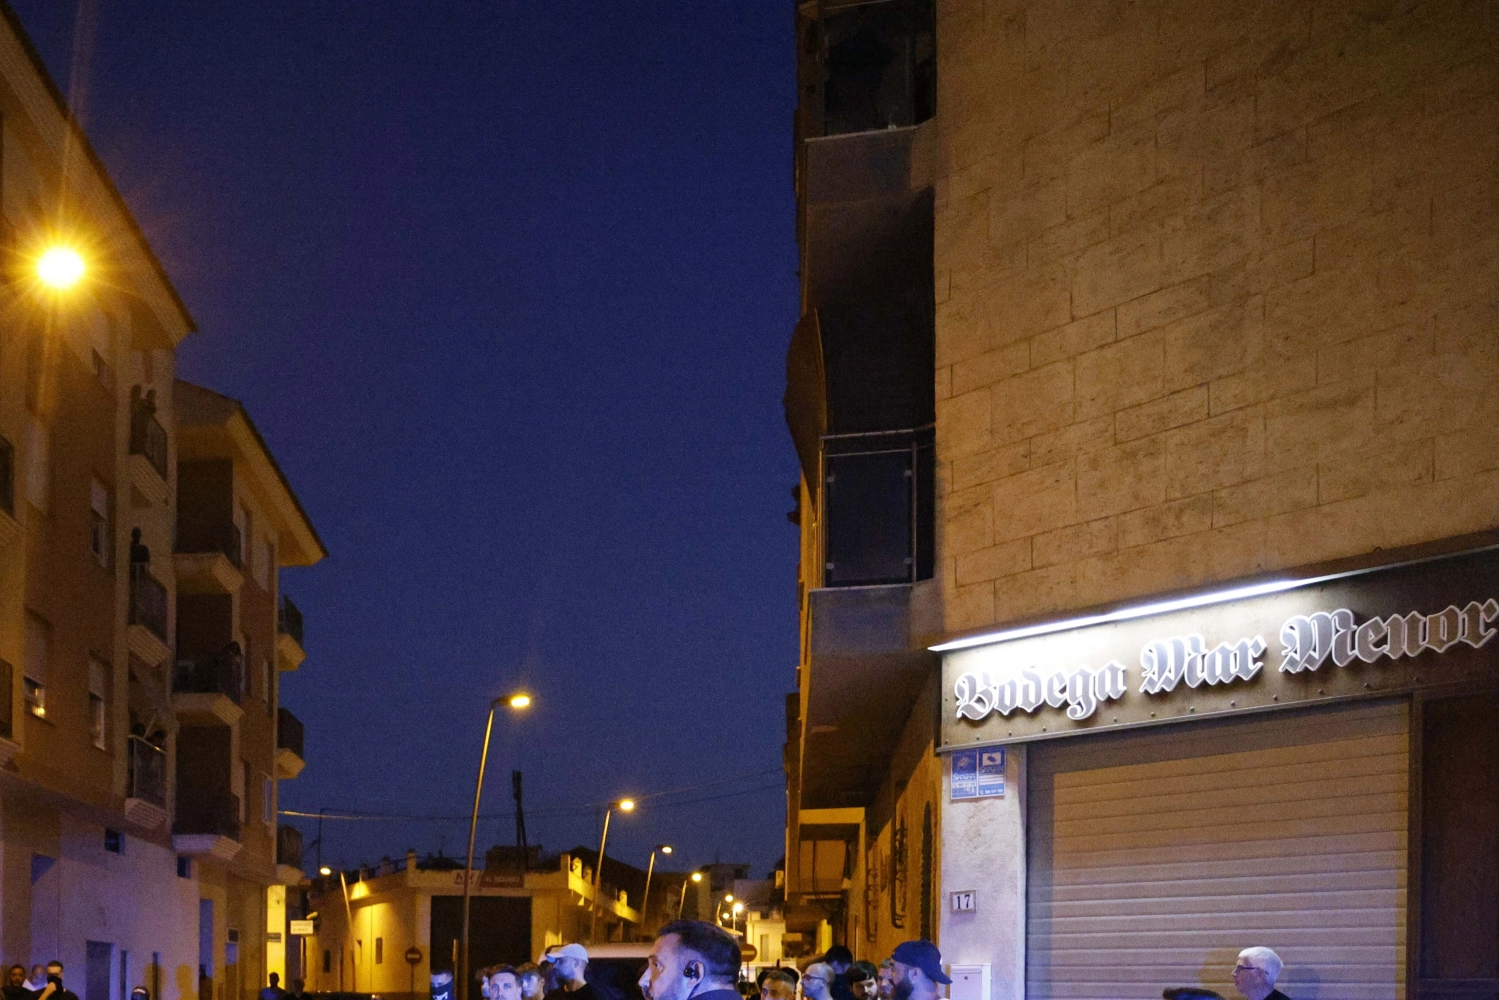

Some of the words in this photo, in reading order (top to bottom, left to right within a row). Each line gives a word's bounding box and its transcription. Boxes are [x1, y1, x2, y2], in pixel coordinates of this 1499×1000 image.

[954, 658, 1127, 721] Bodega
[1139, 633, 1268, 695] Mar
[1279, 598, 1499, 674] Menor
[957, 894, 971, 909] 17
